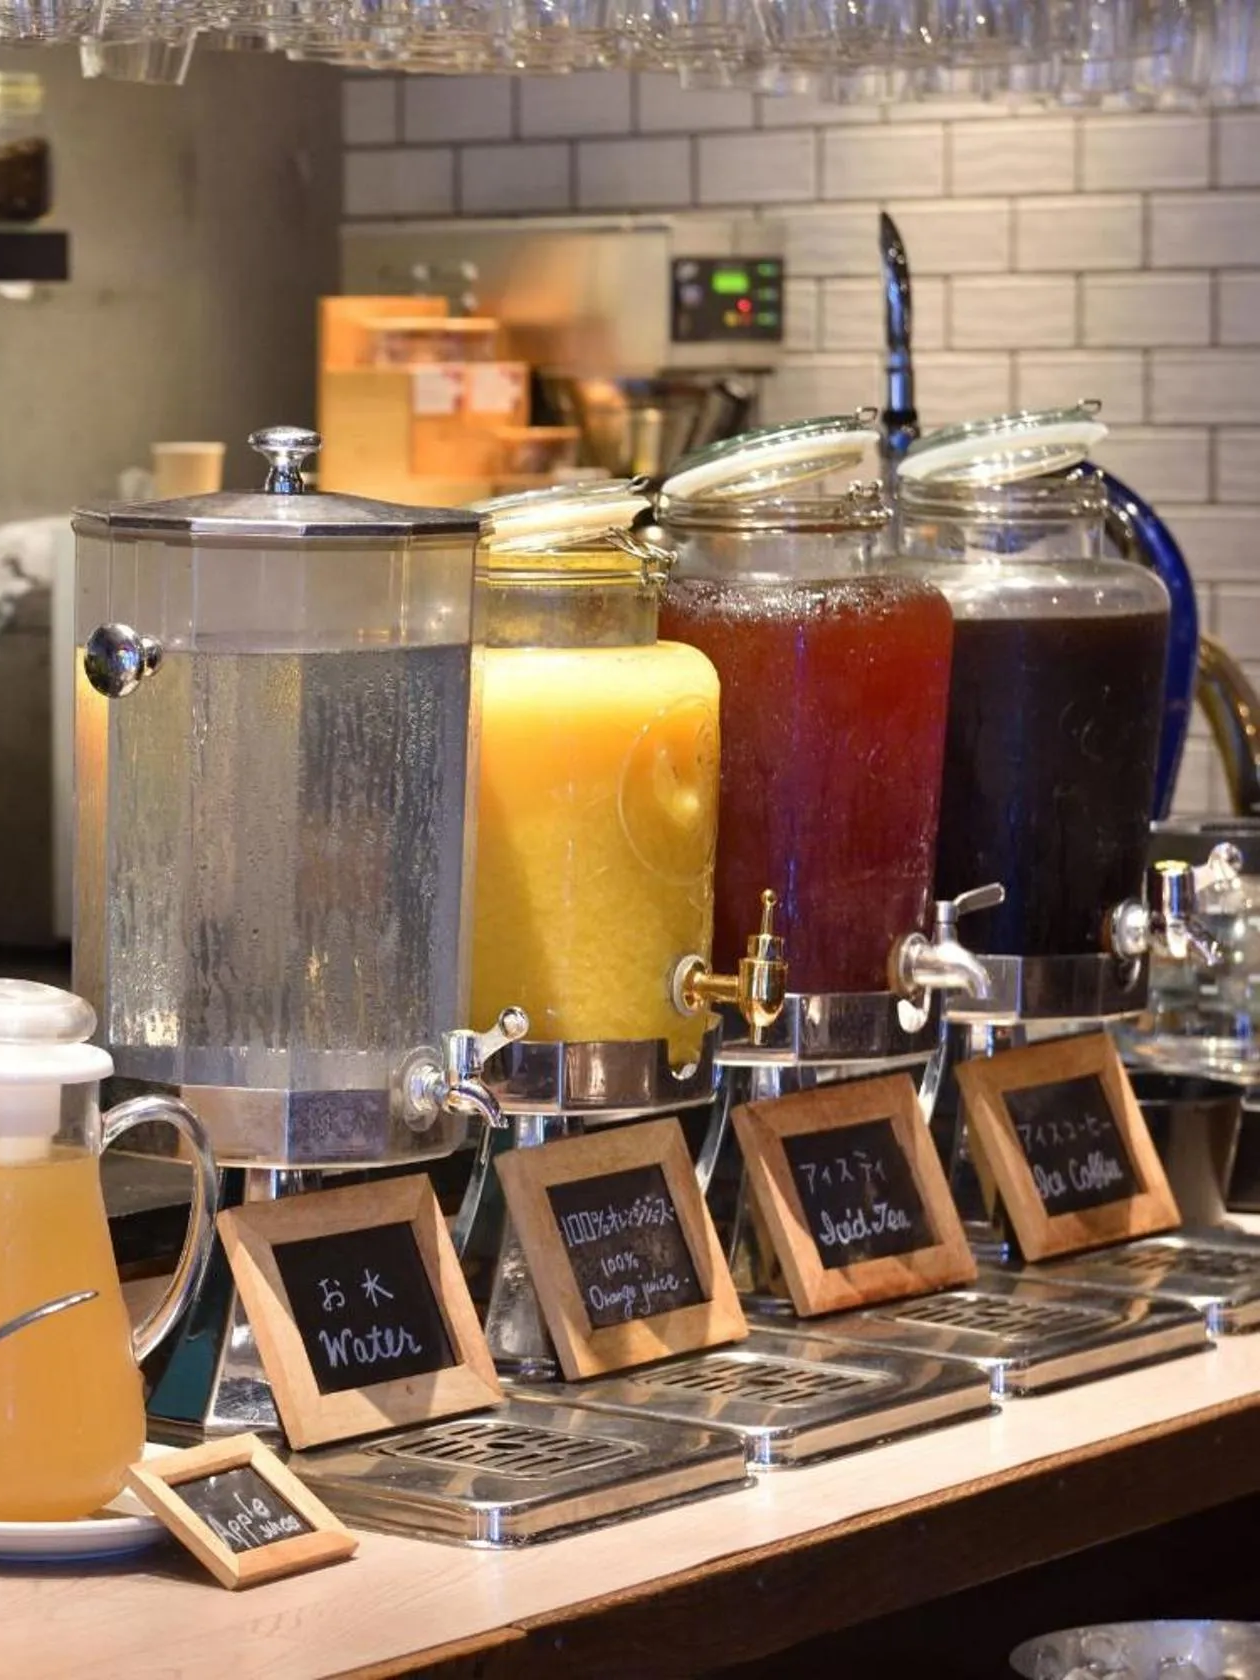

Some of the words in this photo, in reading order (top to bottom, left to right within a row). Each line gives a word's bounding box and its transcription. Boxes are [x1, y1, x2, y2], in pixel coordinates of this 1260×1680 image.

[600, 1252, 639, 1279] 100%
[317, 1268, 394, 1312] お水
[318, 1324, 423, 1370] Water
[206, 1491, 272, 1551] Apple
